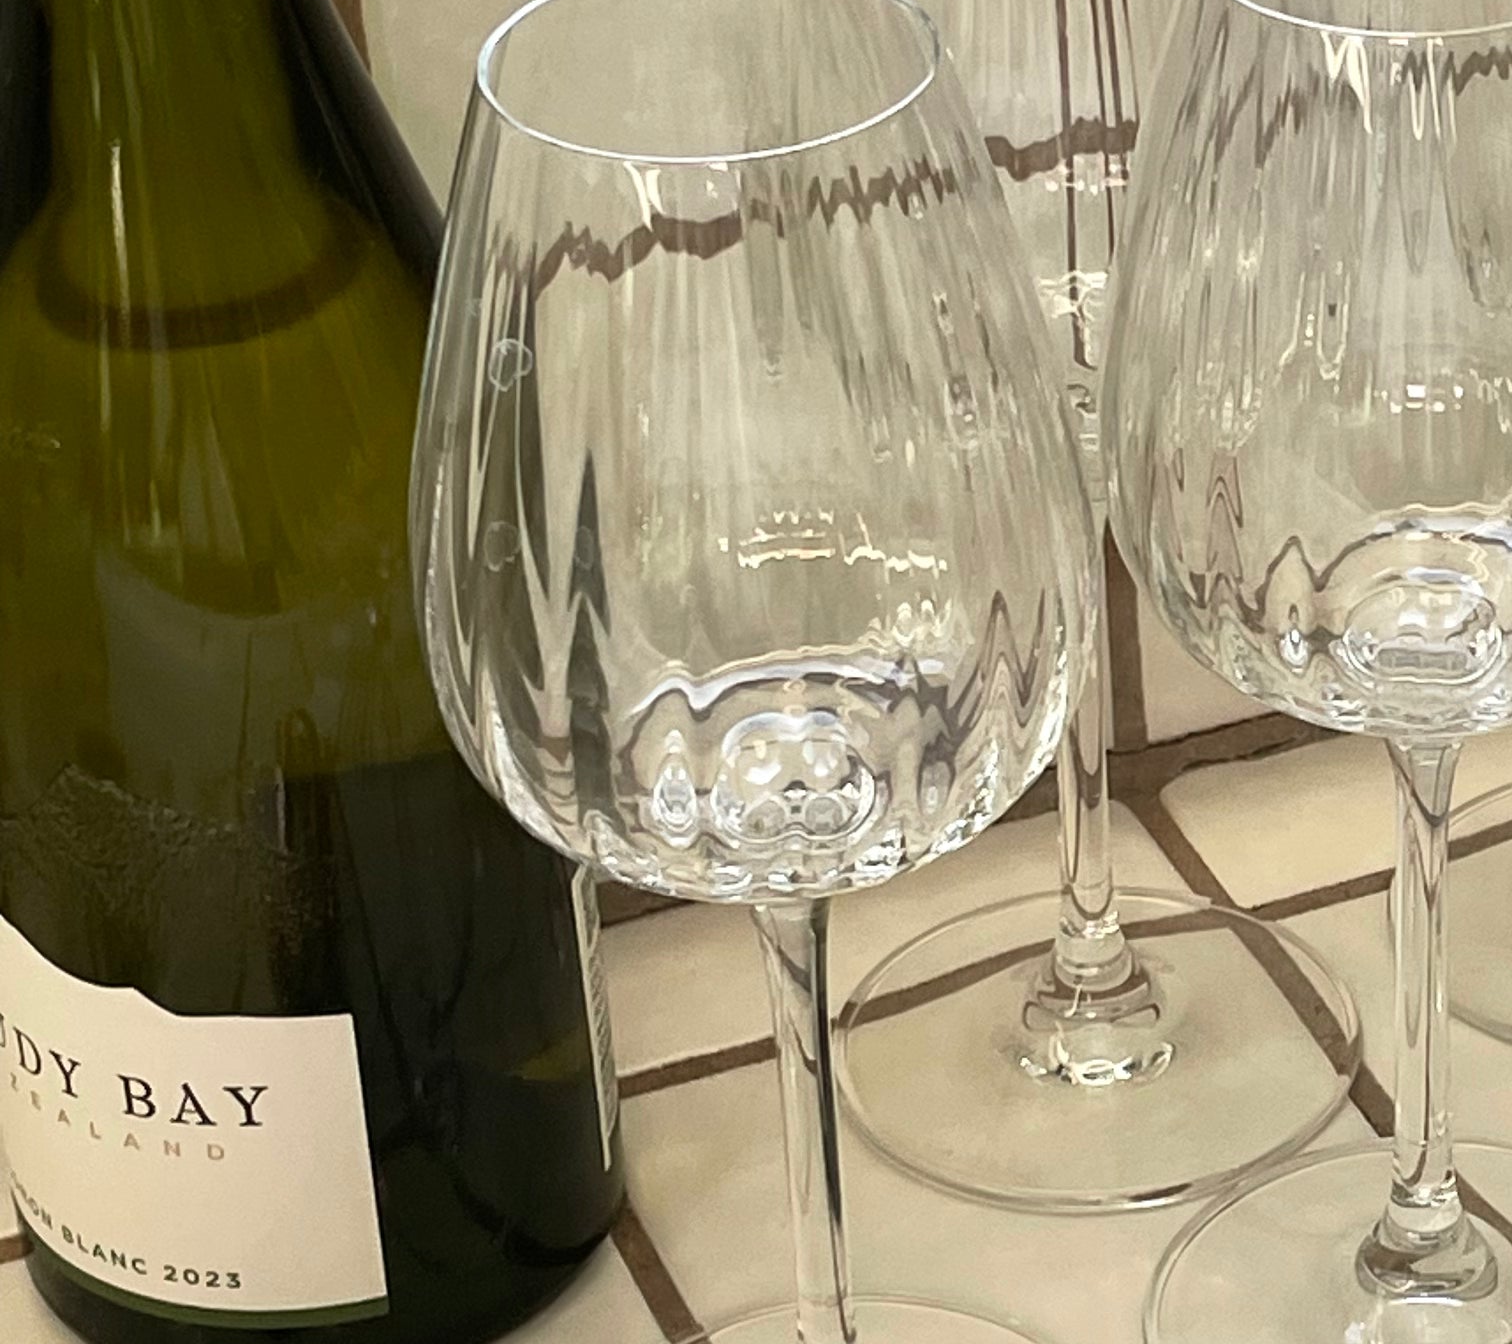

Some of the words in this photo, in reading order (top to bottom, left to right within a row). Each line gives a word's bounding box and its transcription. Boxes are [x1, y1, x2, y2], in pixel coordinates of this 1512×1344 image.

[10, 1071, 226, 1161] ZEALAND
[116, 1073, 269, 1128] BAY
[61, 1224, 148, 1276] BLANC
[163, 1263, 243, 1290] 2023
